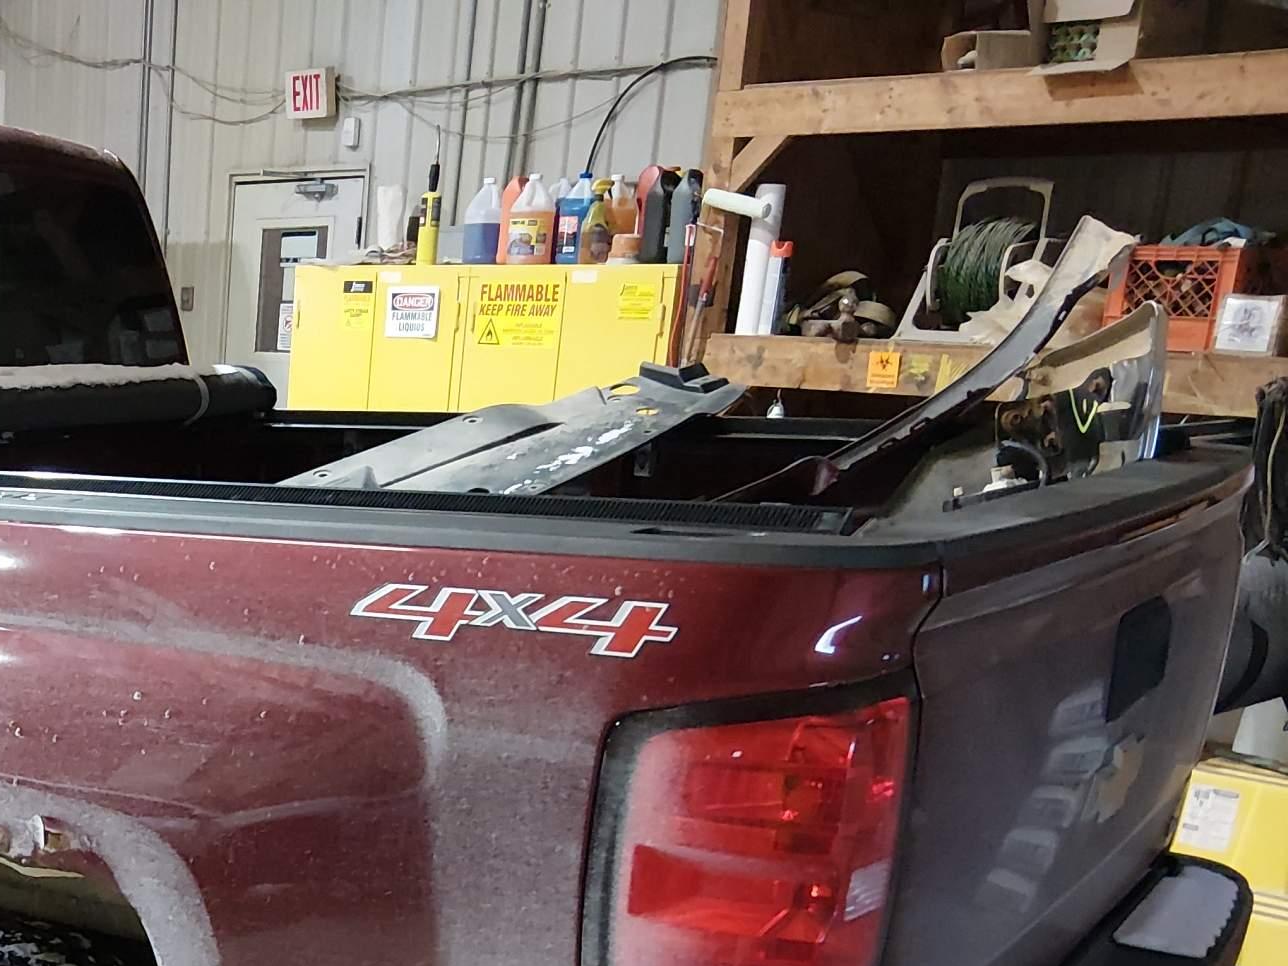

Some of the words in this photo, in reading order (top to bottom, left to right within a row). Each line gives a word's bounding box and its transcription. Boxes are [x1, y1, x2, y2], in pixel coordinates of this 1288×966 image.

[292, 74, 320, 112] EXIT
[480, 283, 561, 303] FLAMMABLE
[395, 295, 431, 309] DANGER
[391, 311, 433, 322] FLAMMABLE
[479, 303, 504, 317] KEEP
[505, 303, 527, 317] FIRE
[528, 303, 558, 318] AWAY
